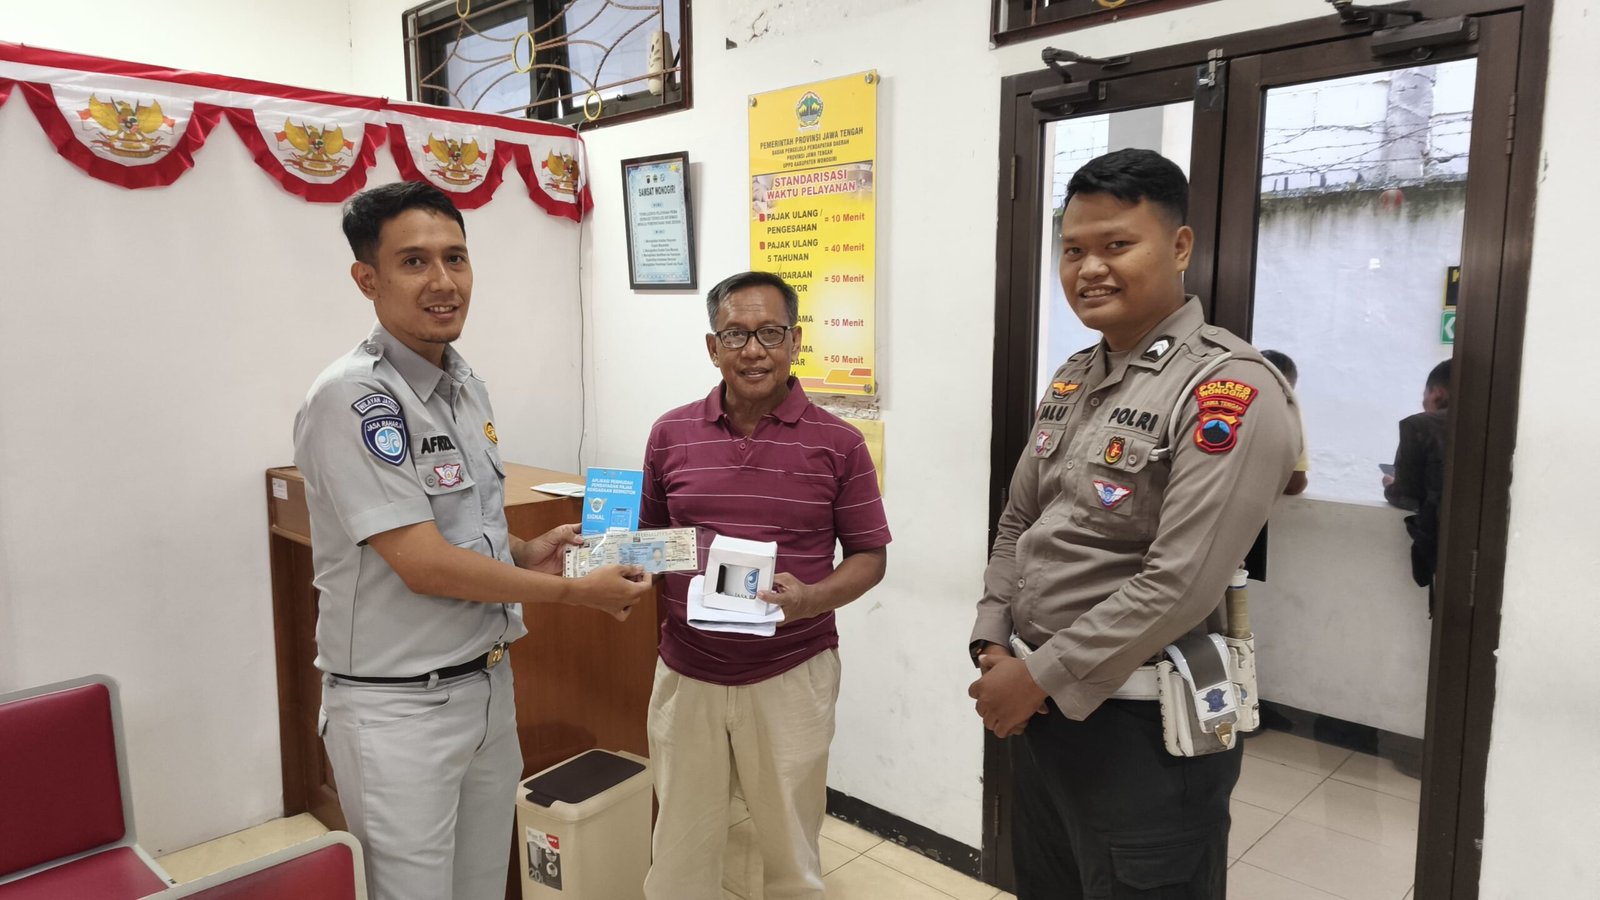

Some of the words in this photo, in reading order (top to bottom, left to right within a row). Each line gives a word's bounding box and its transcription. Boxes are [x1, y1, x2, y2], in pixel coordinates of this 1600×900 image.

[760, 138, 794, 150] PEMERINTAH
[795, 134, 821, 144] PROVINSI
[822, 131, 838, 140] JAWA
[840, 127, 864, 137] TENGAH
[833, 139, 849, 147] DAERAH
[794, 159, 816, 167] KABUPATEN
[817, 156, 837, 164] WONOGIRI
[774, 170, 847, 187] STANDARISASI
[767, 188, 798, 200] WAKTU
[801, 182, 856, 196] PELAYANAN
[767, 212, 790, 221] PAJAK
[793, 210, 818, 219] ULANG
[832, 214, 840, 223] 10
[843, 213, 864, 222] Menit
[767, 223, 817, 234] PENGESAHAN
[767, 240, 790, 249] PAJAK
[793, 238, 818, 247] ULANG
[831, 244, 840, 252] 40
[843, 243, 864, 252] Menit
[774, 254, 809, 262] TAHUNAN
[831, 275, 840, 283] 50
[843, 274, 864, 283] Menit
[830, 319, 840, 327] 50
[842, 319, 864, 327] Menit
[830, 355, 840, 363] 50
[842, 355, 864, 364] Menit
[1199, 382, 1251, 395] POLRES
[1199, 388, 1249, 401] WONOGIRI
[1108, 407, 1159, 431] POLRI
[366, 422, 381, 432] JASA
